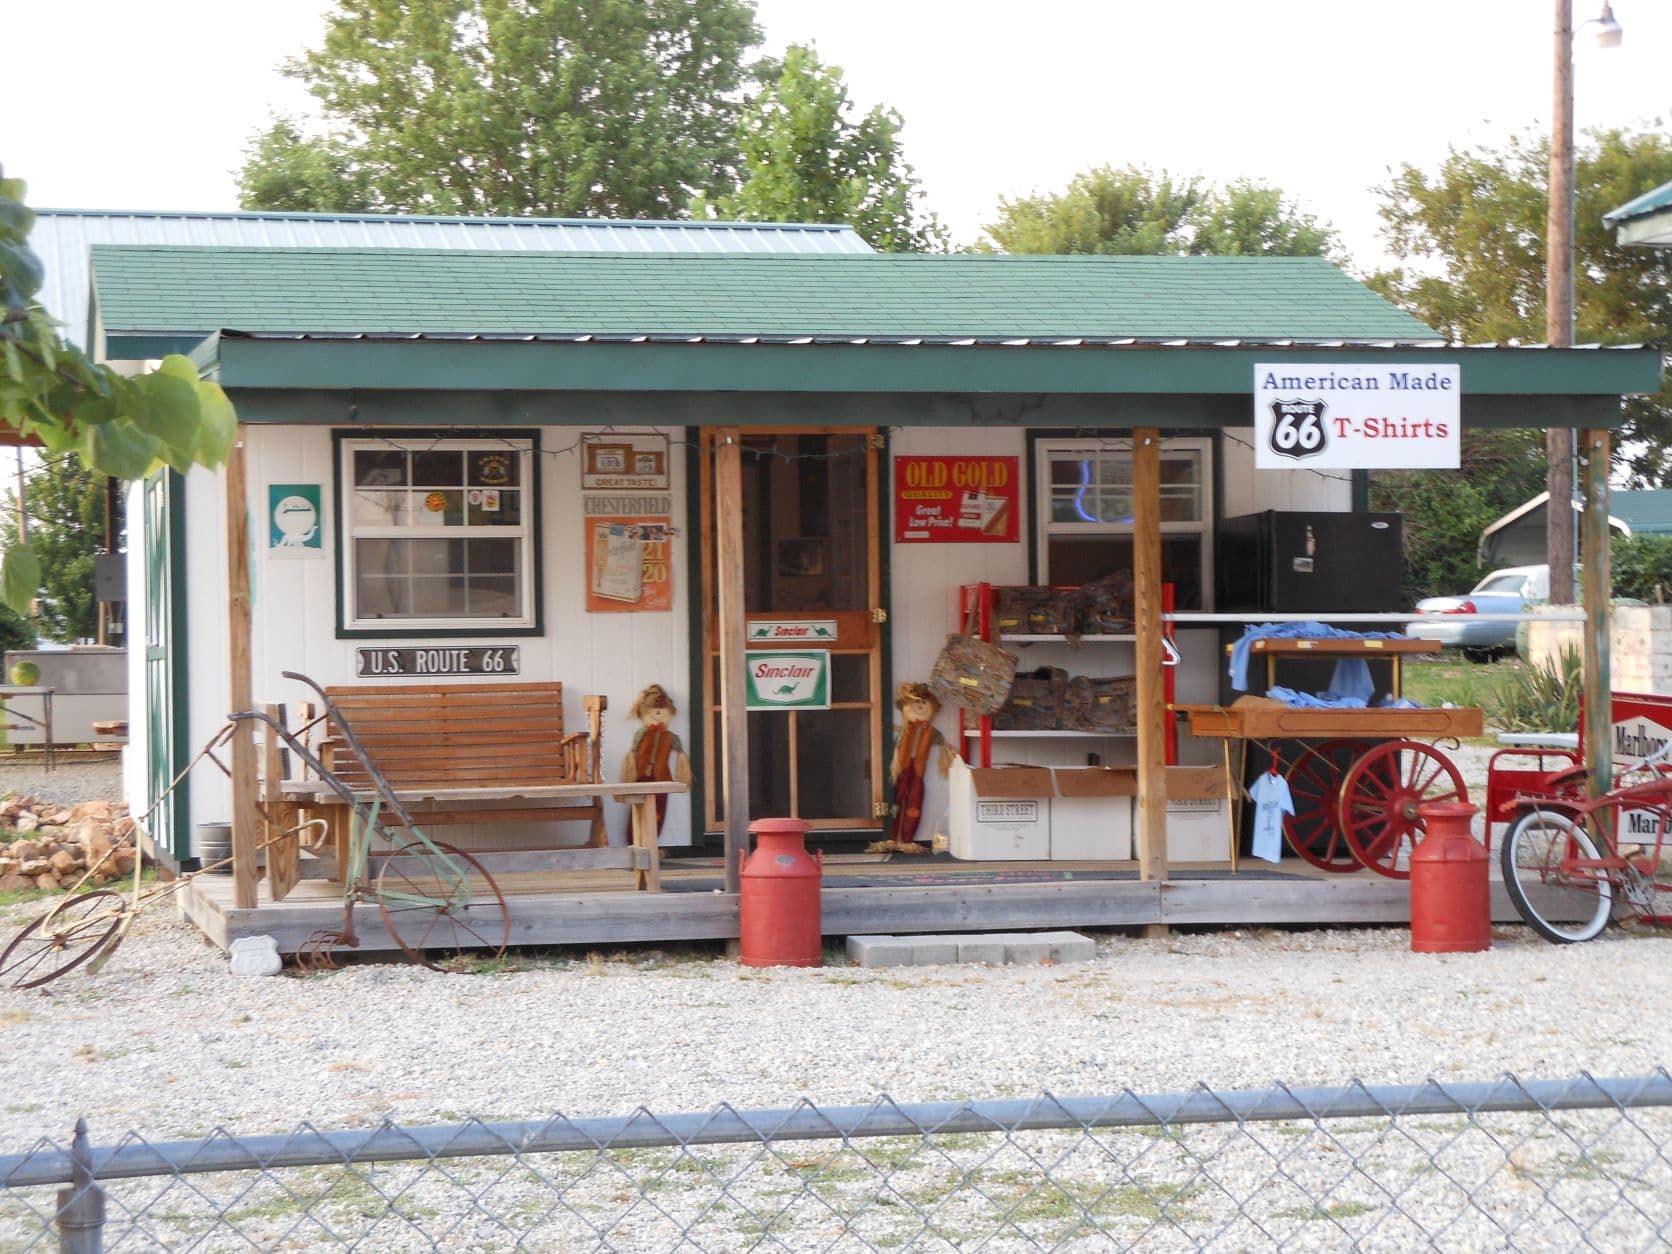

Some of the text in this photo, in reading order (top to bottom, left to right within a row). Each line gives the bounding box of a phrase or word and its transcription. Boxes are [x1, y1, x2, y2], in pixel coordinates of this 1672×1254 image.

[1263, 372, 1451, 391] American Made
[1282, 404, 1316, 414] ROUTE
[1275, 414, 1321, 450] 66
[1333, 416, 1450, 438] T-Shirts
[906, 461, 1008, 488] OLD GOLD
[584, 496, 671, 515] CHESTERFIELD
[916, 505, 941, 515] Great
[642, 564, 667, 583] 20
[774, 626, 809, 637] Sinclair
[371, 649, 504, 674] U.S. ROUTE 66
[755, 663, 816, 678] Sinclair
